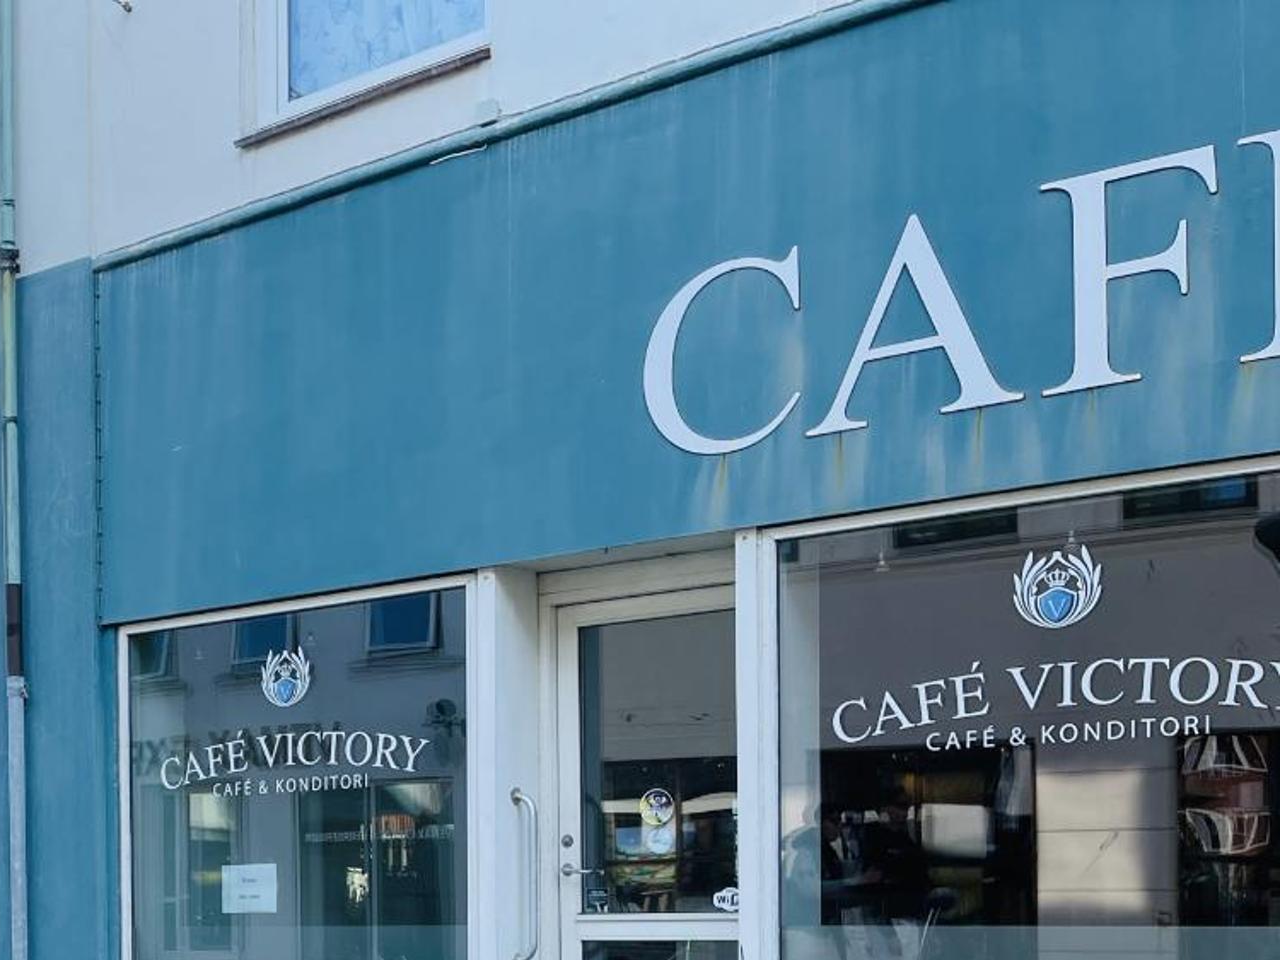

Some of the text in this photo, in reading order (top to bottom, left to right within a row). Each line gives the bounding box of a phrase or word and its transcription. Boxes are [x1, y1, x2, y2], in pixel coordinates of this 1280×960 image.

[832, 656, 1280, 743] CAFÉ VICTOR
[926, 714, 1210, 752] CAFÉ & KONDITORI
[160, 730, 249, 790] CAFÉ
[256, 730, 430, 772] VICTORY
[212, 773, 369, 798] CAFÉ & KONDITORI
